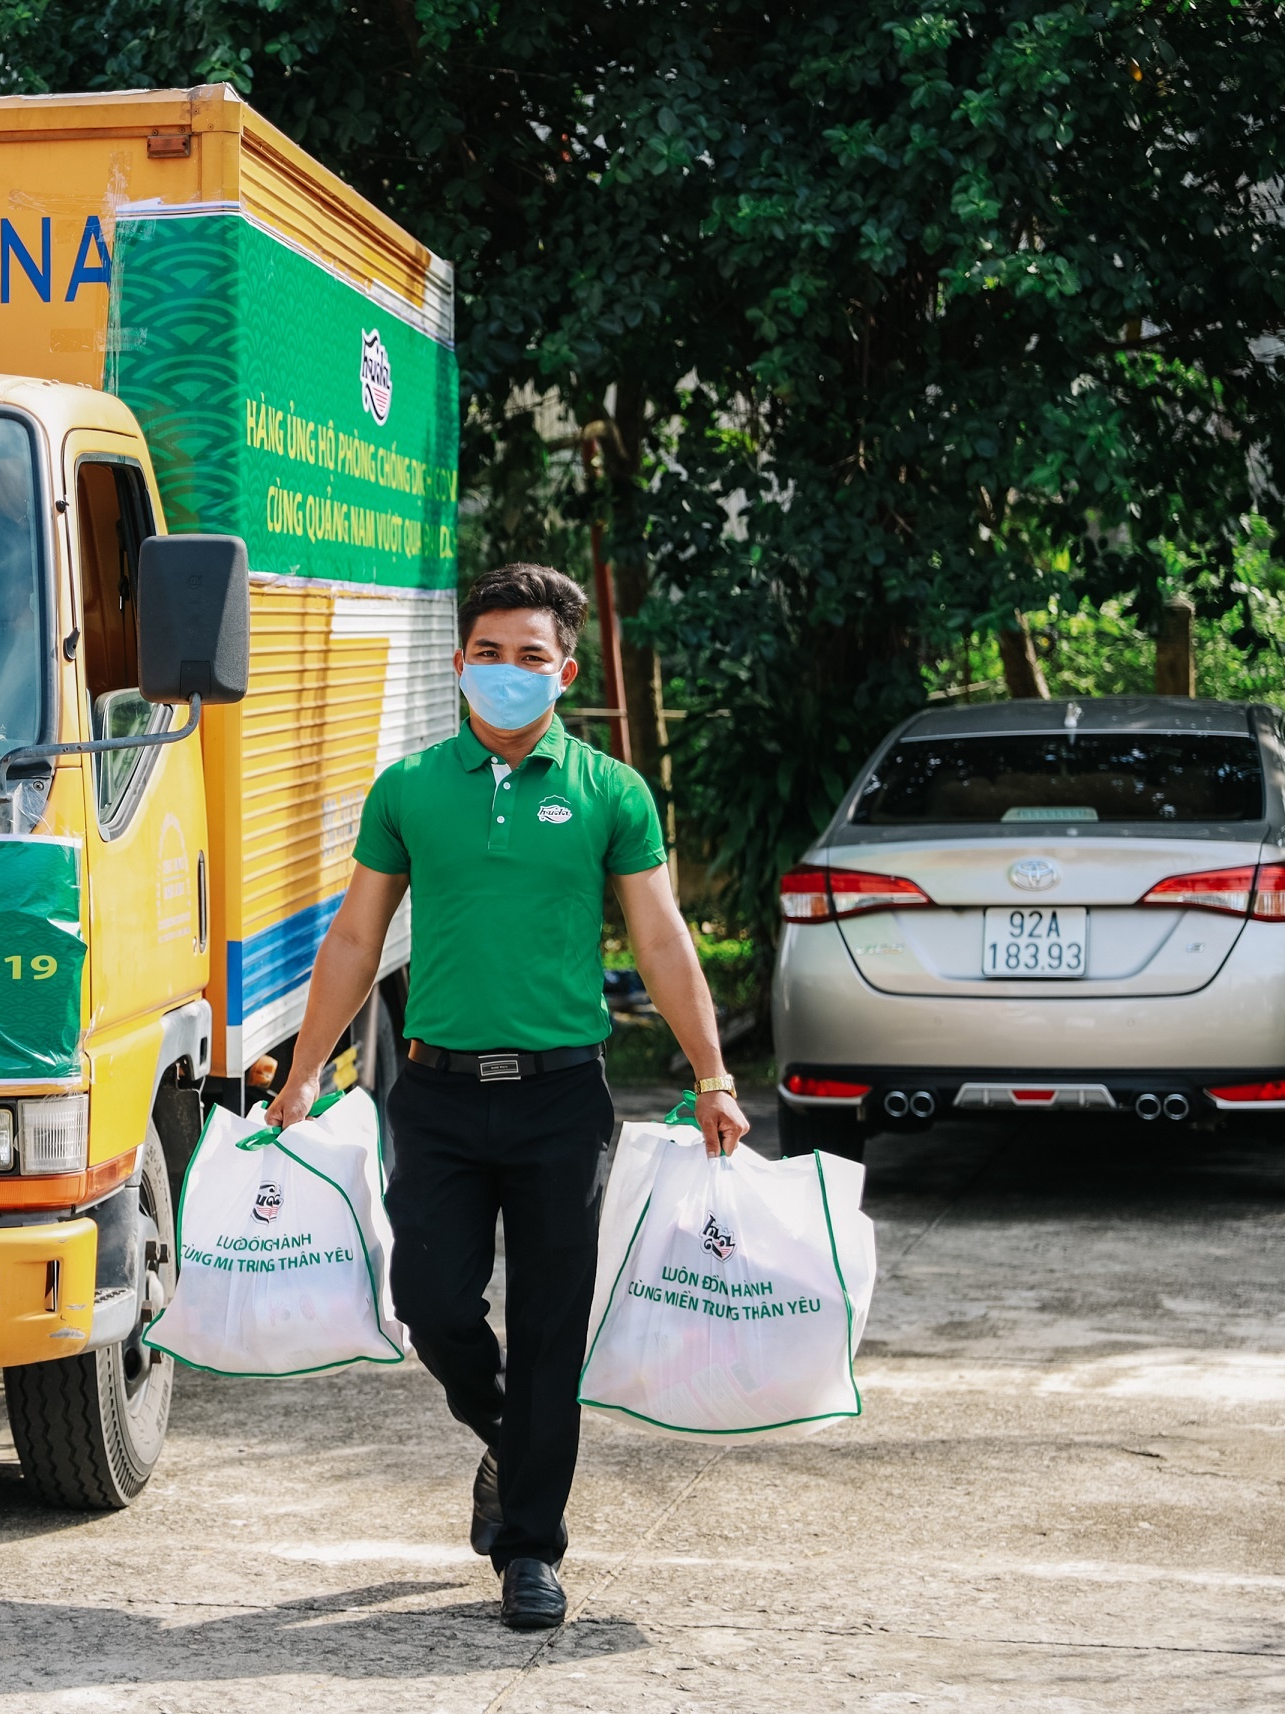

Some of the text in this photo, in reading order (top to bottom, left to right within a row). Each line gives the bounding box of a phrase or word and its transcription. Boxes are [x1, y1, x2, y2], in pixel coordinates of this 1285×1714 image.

[246, 391, 284, 456] HÀNG
[287, 400, 316, 464] ỦNG
[318, 419, 336, 482] HỘ
[338, 429, 376, 483] PHÒNG
[377, 440, 411, 493] CHỐNG
[267, 477, 304, 536] CÙNG
[306, 485, 349, 544] QUẢNG
[351, 505, 375, 549] NAM
[376, 508, 403, 563] VƯỢT
[404, 519, 421, 559] QUA
[1009, 910, 1061, 938] 92A
[989, 943, 1082, 969] 183.93
[278, 1251, 321, 1270] THÂN
[324, 1246, 354, 1263] YÊU
[661, 1266, 699, 1287] LUÔN
[731, 1280, 773, 1298] HÀNH
[628, 1279, 662, 1301] CÙNG
[664, 1290, 699, 1311] MIỀN
[742, 1301, 784, 1320] THÂN
[787, 1296, 821, 1314] YÊU
